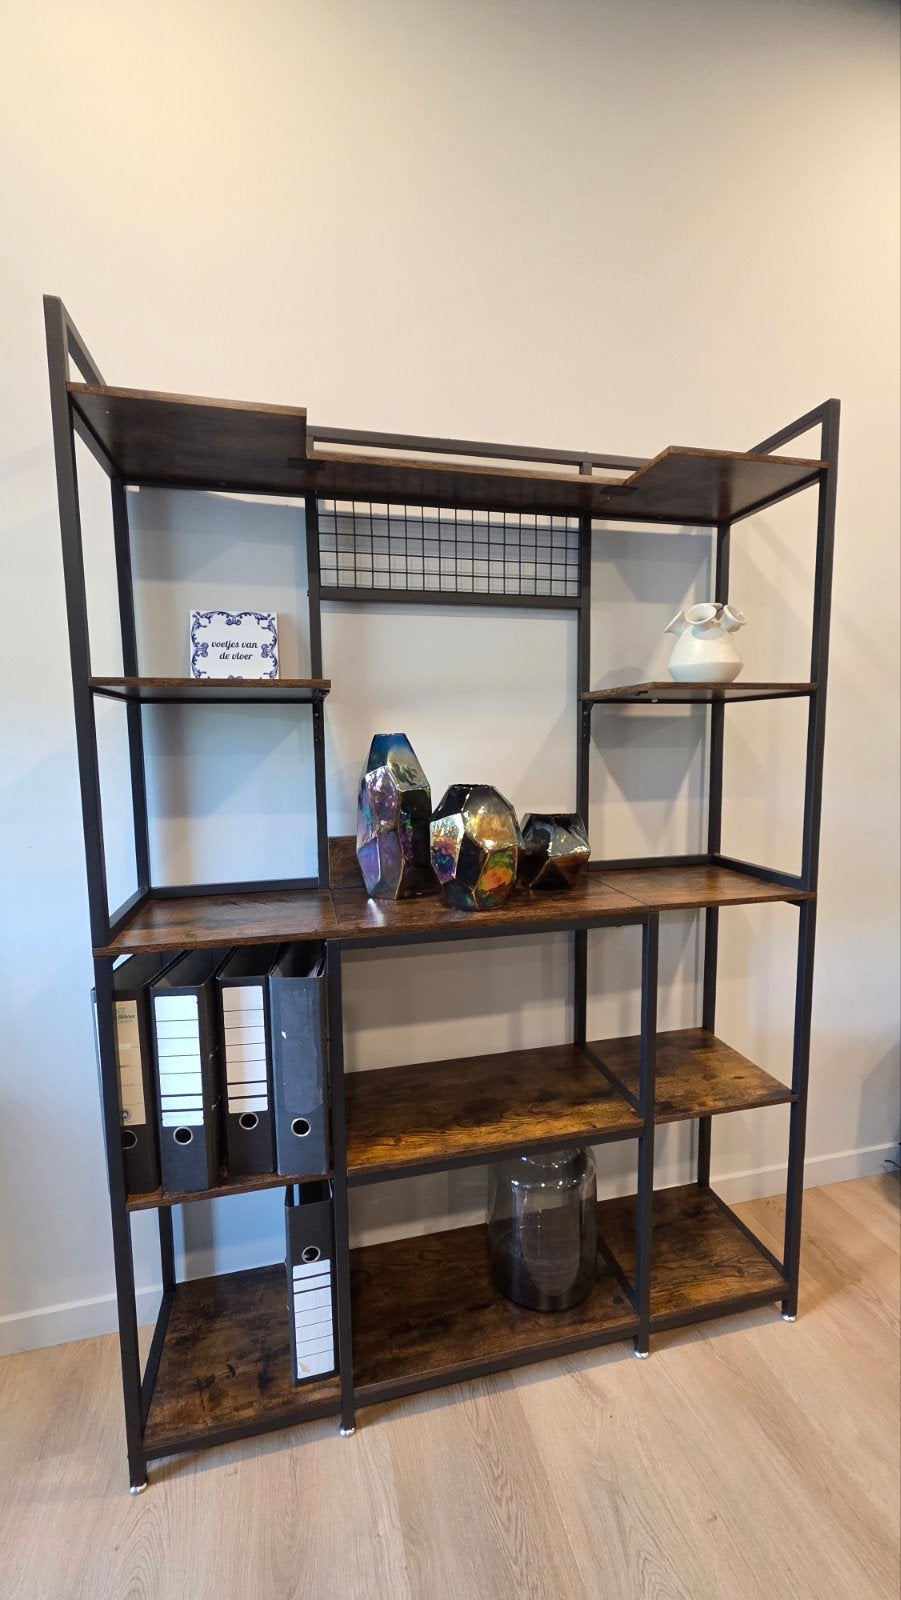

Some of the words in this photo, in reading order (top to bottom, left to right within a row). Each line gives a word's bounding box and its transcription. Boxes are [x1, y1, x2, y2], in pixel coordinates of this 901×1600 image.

[211, 640, 240, 650] voetjes
[219, 652, 230, 660] de
[231, 652, 254, 660] vloer
